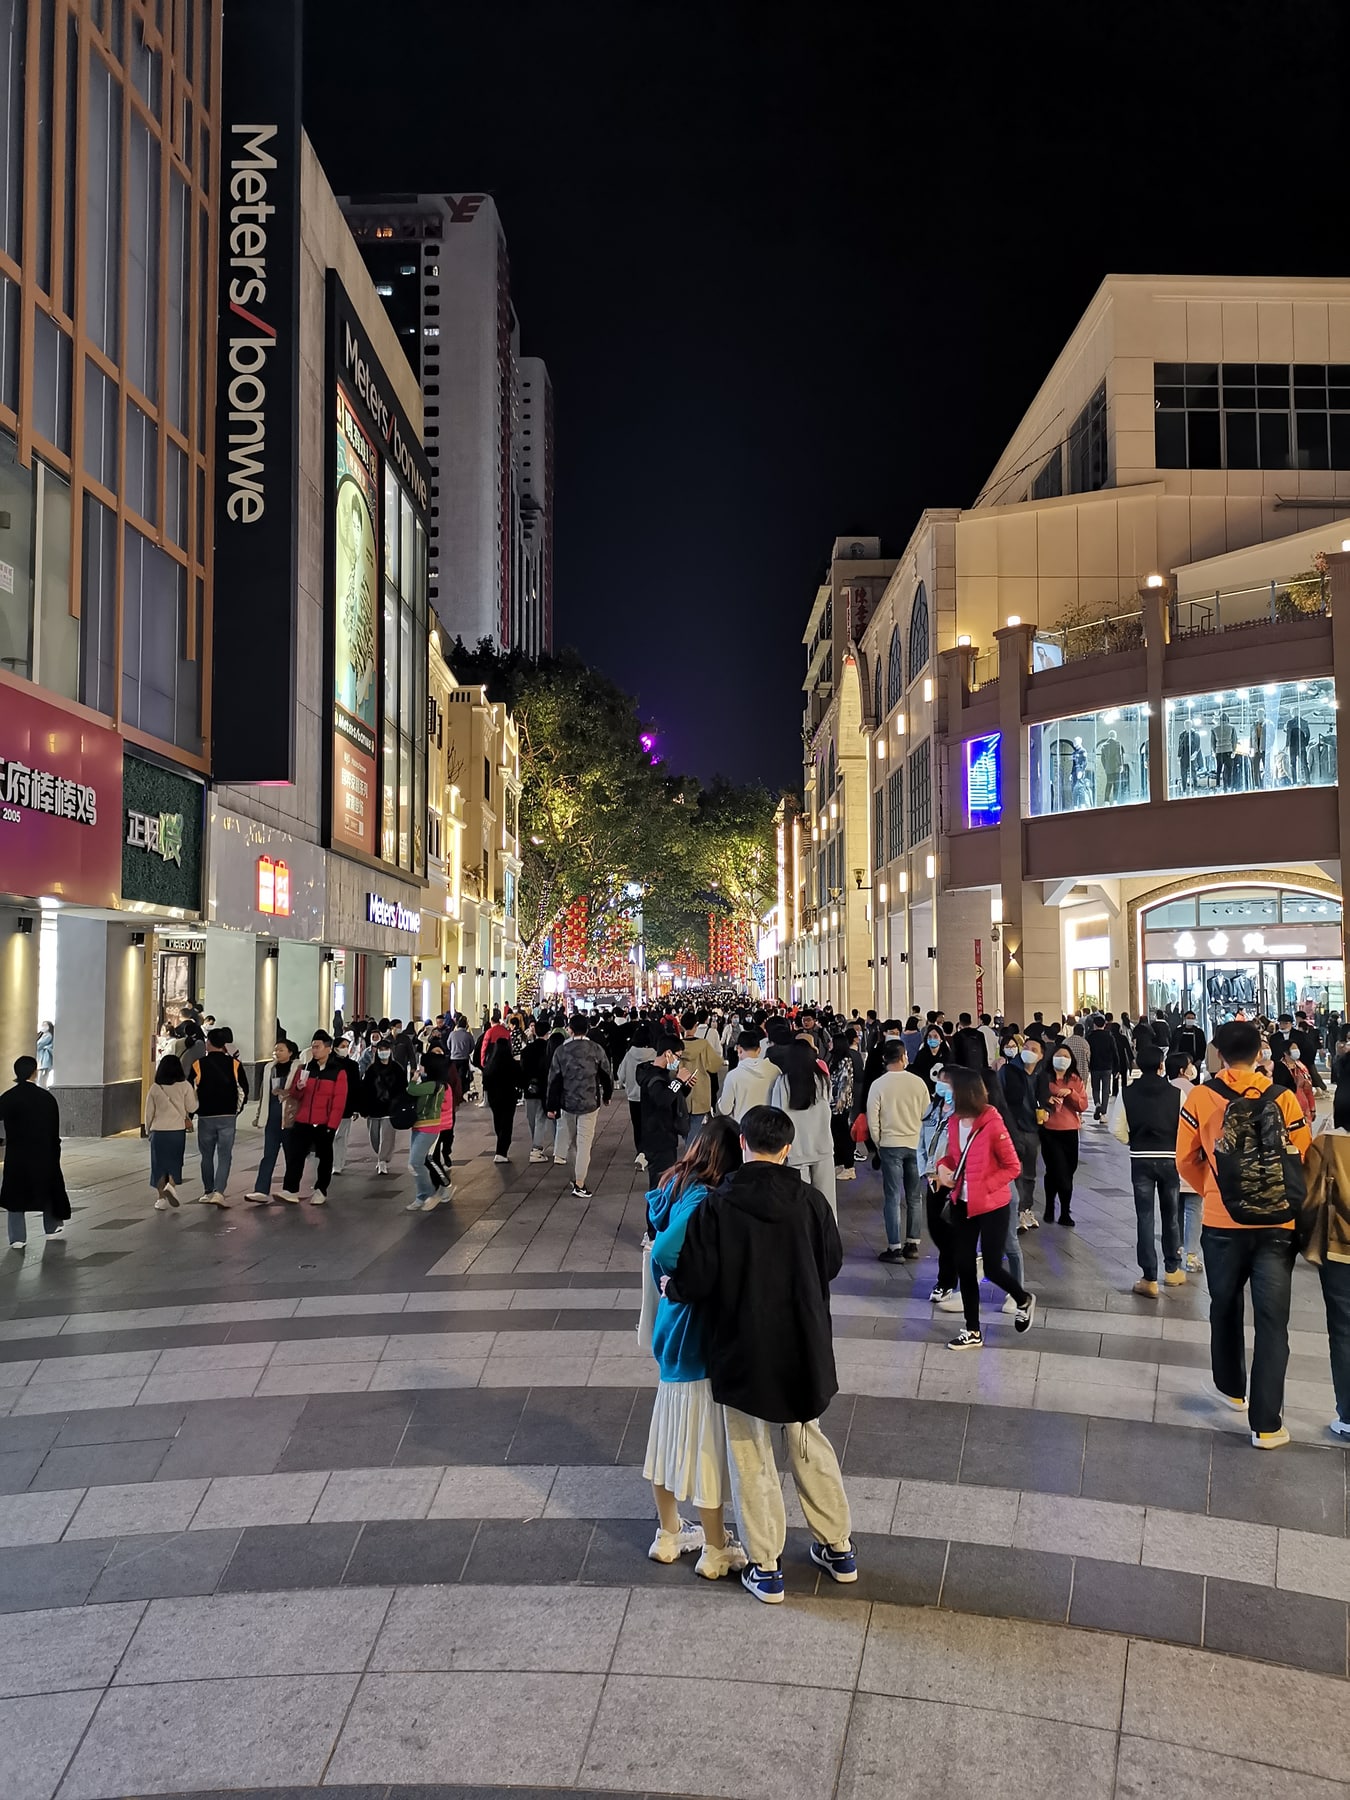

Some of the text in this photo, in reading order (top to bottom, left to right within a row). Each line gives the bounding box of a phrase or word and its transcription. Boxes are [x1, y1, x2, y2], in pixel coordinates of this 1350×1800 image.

[227, 124, 278, 523] Meters/bonwe
[345, 321, 427, 510] Meters/bonwe
[0, 757, 97, 826] 府棒棒鸡
[3, 807, 21, 823] 2005
[370, 892, 420, 933] Meters/bonwe
